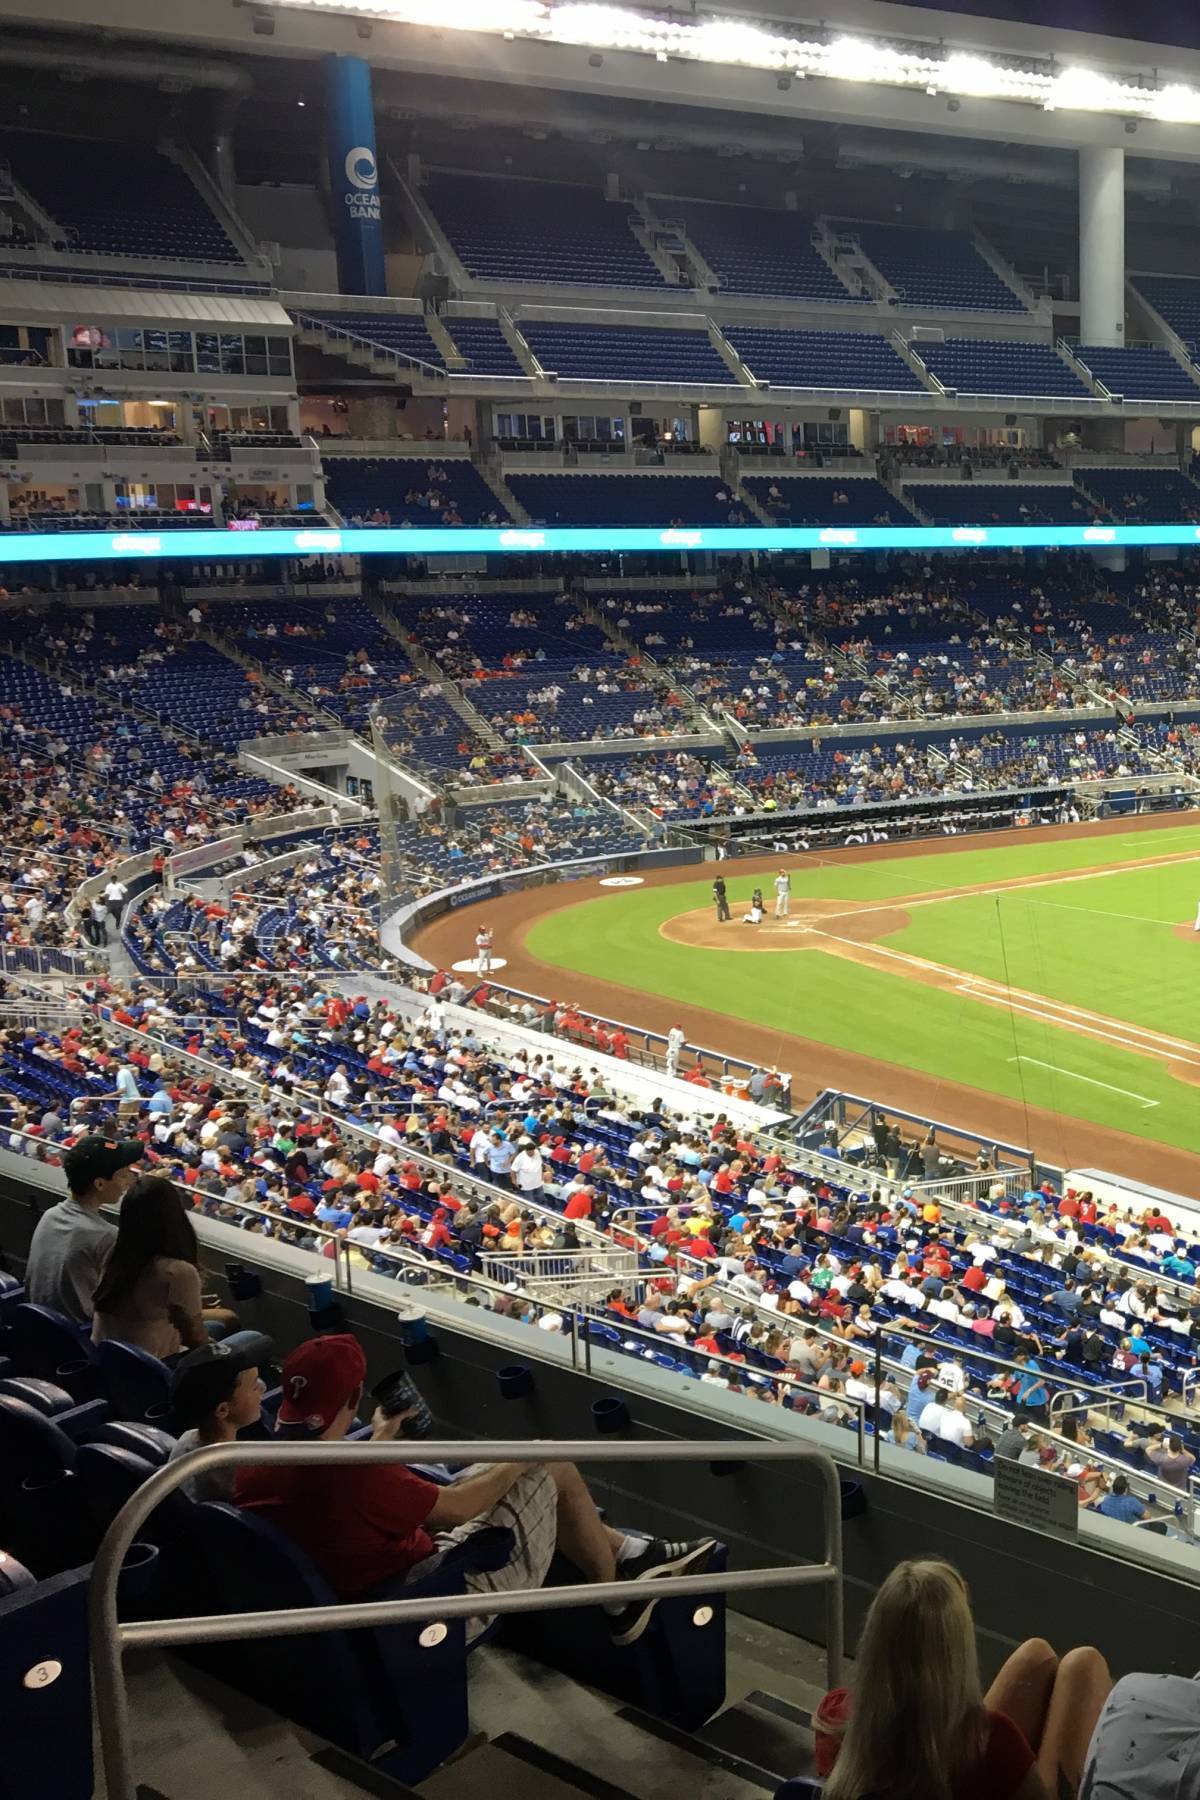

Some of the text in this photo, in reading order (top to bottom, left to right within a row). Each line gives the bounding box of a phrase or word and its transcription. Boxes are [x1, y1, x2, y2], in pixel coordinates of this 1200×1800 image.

[290, 1375, 308, 1399] P
[428, 1629, 438, 1642] 2
[36, 1667, 49, 1682] 3
